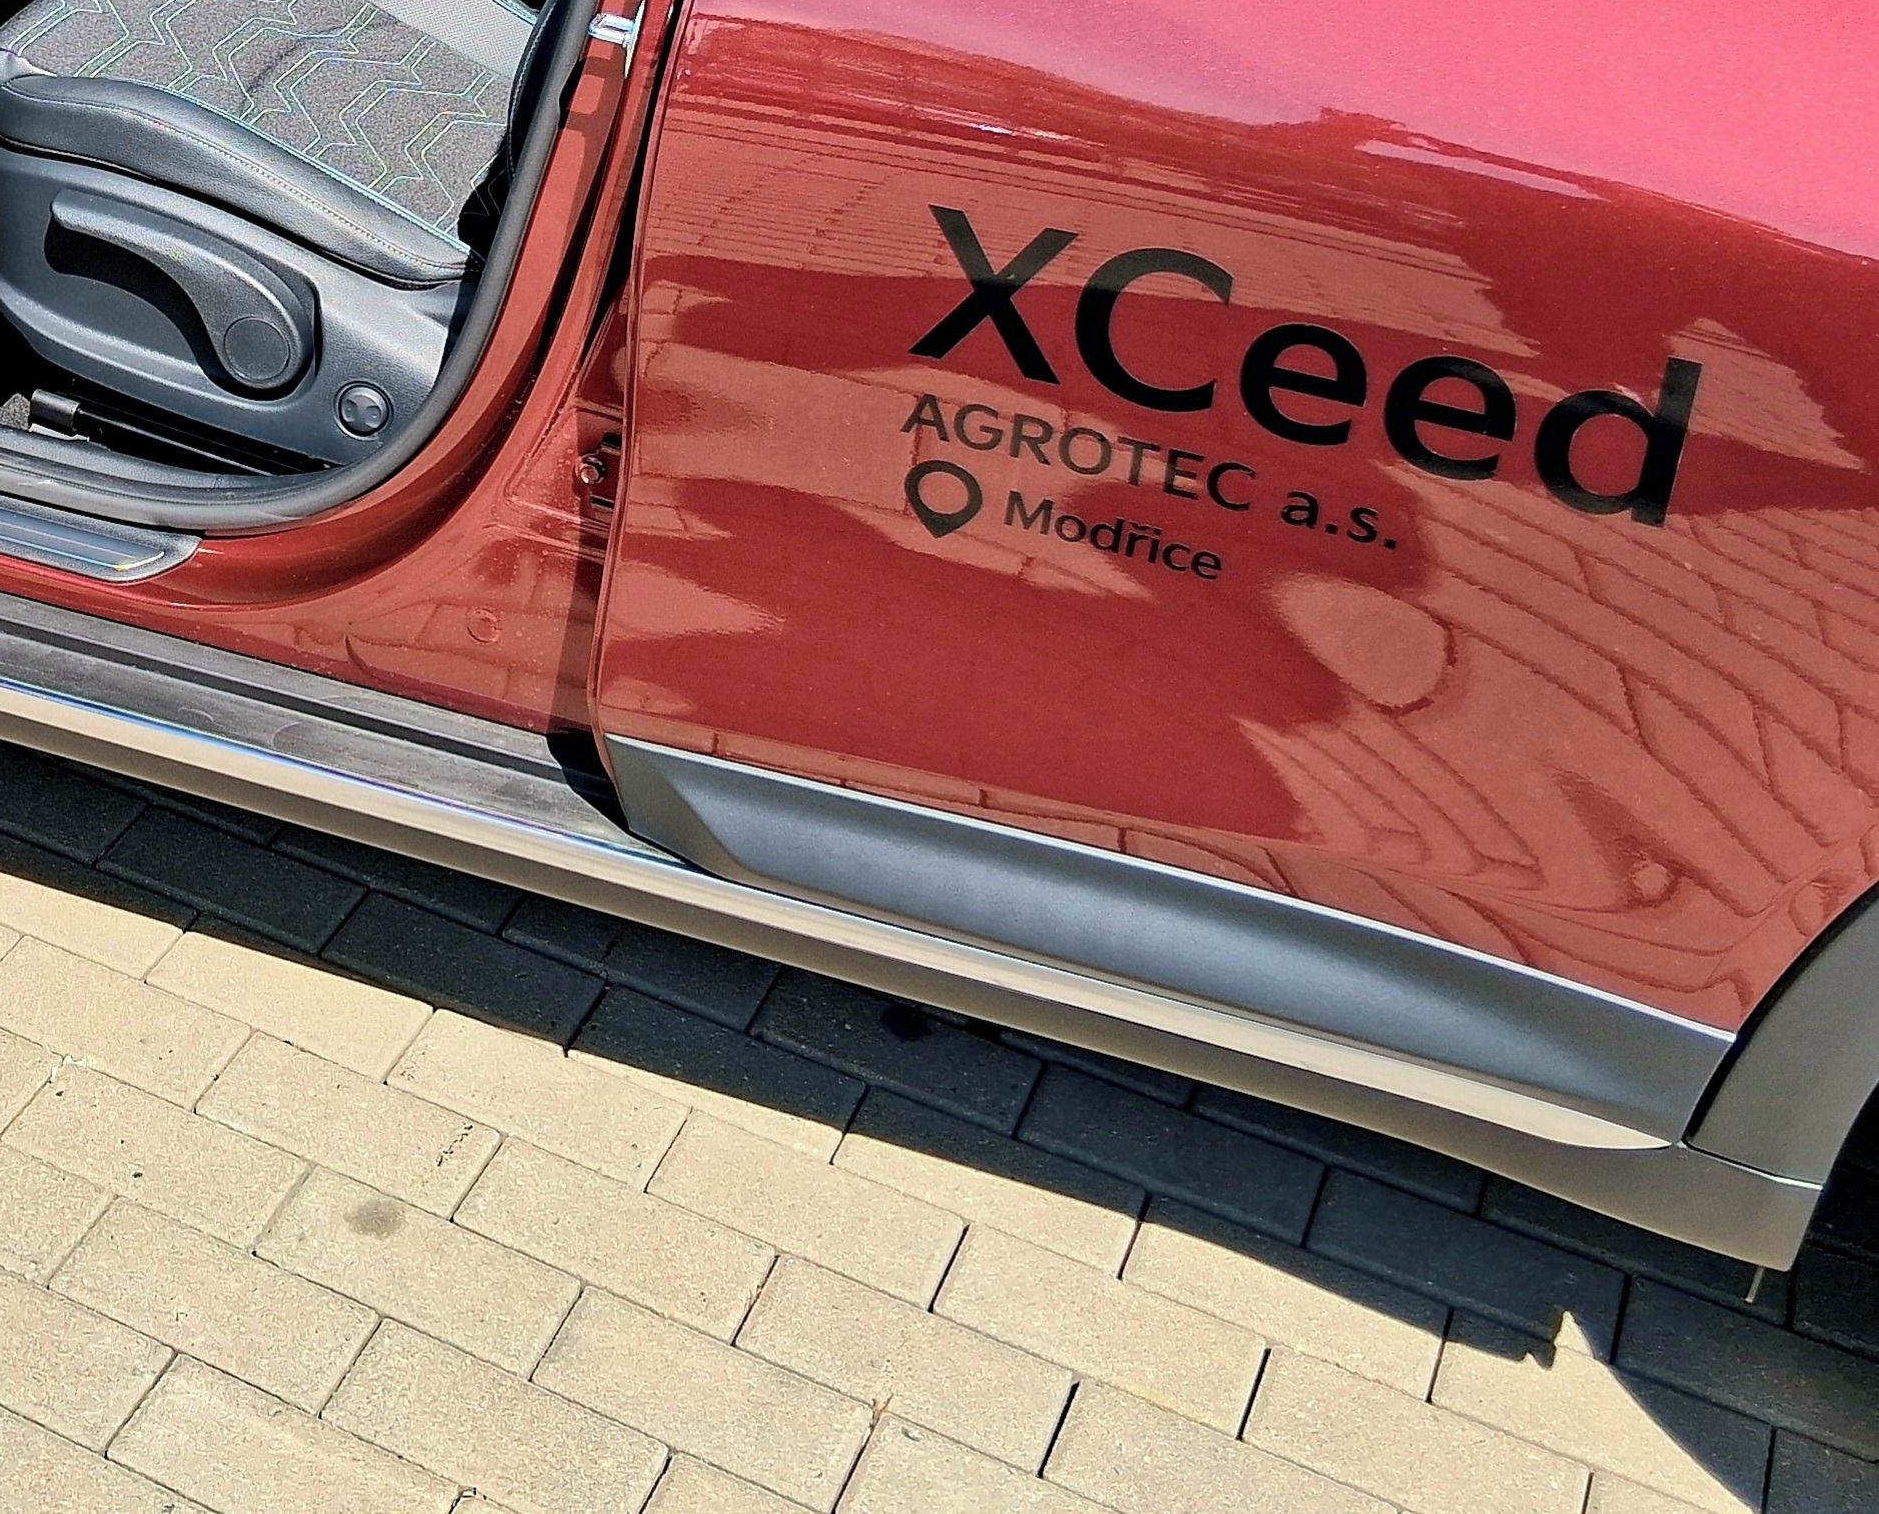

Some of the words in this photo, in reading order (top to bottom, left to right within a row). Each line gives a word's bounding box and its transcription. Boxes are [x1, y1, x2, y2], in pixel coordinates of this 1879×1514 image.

[908, 203, 1704, 527] XCeed
[900, 393, 1257, 512] AGROTEC
[1280, 490, 1400, 550] a.s.
[1003, 489, 1223, 581] Modřice
